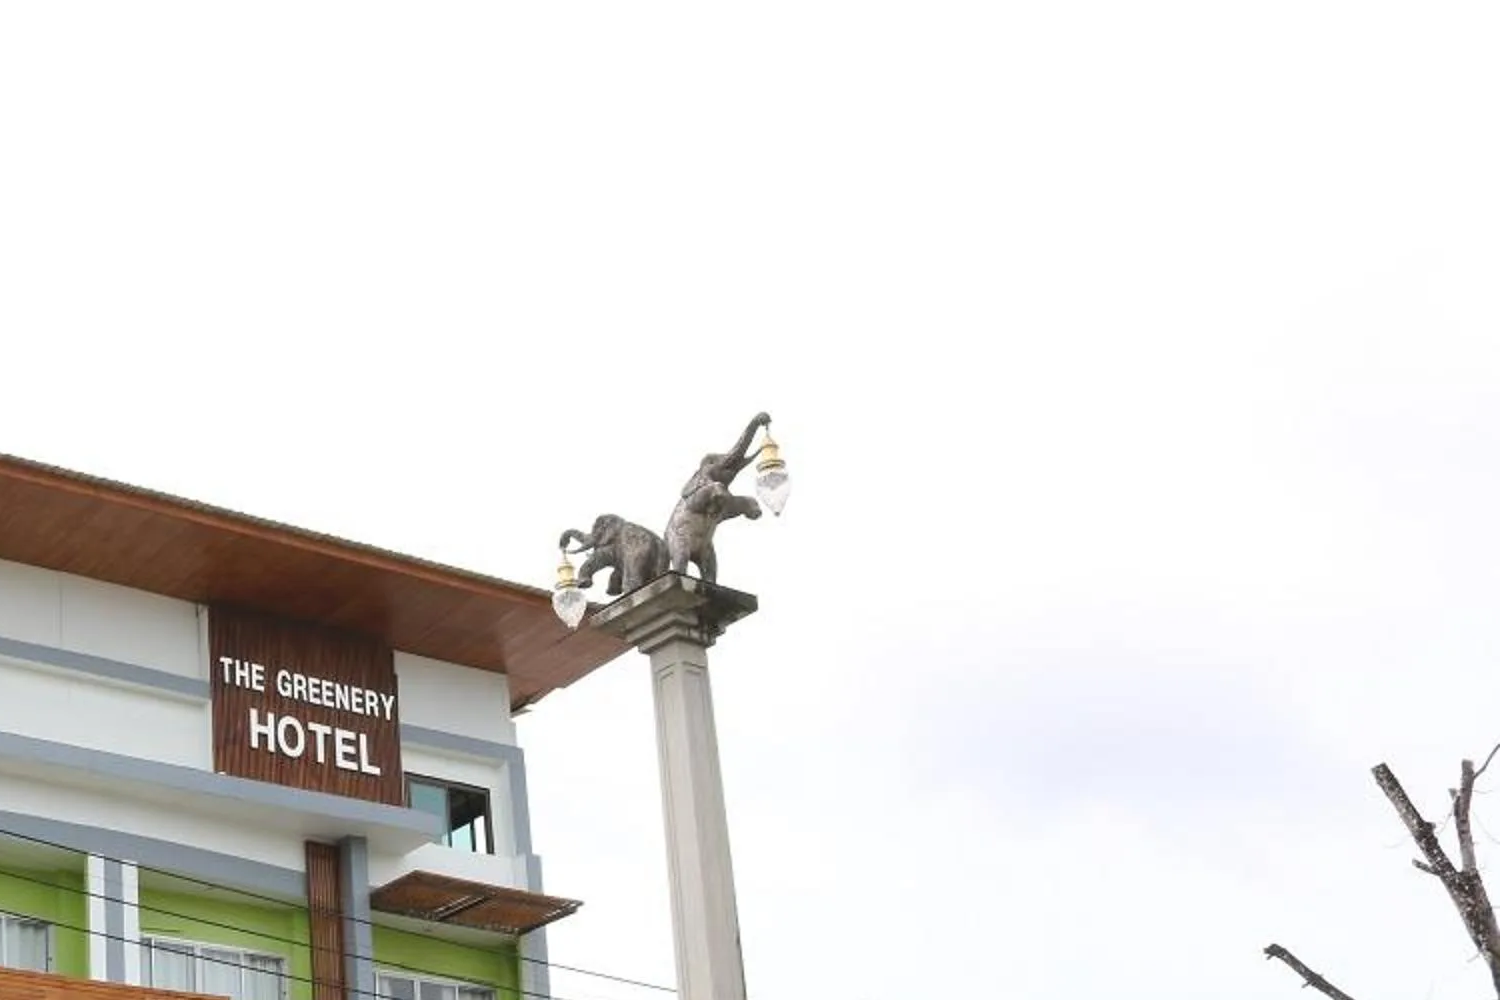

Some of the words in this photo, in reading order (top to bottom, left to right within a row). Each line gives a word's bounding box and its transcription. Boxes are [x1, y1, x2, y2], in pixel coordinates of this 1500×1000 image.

[219, 656, 265, 692] THE
[277, 669, 395, 721] GREENERY
[249, 708, 381, 776] HOTEL
